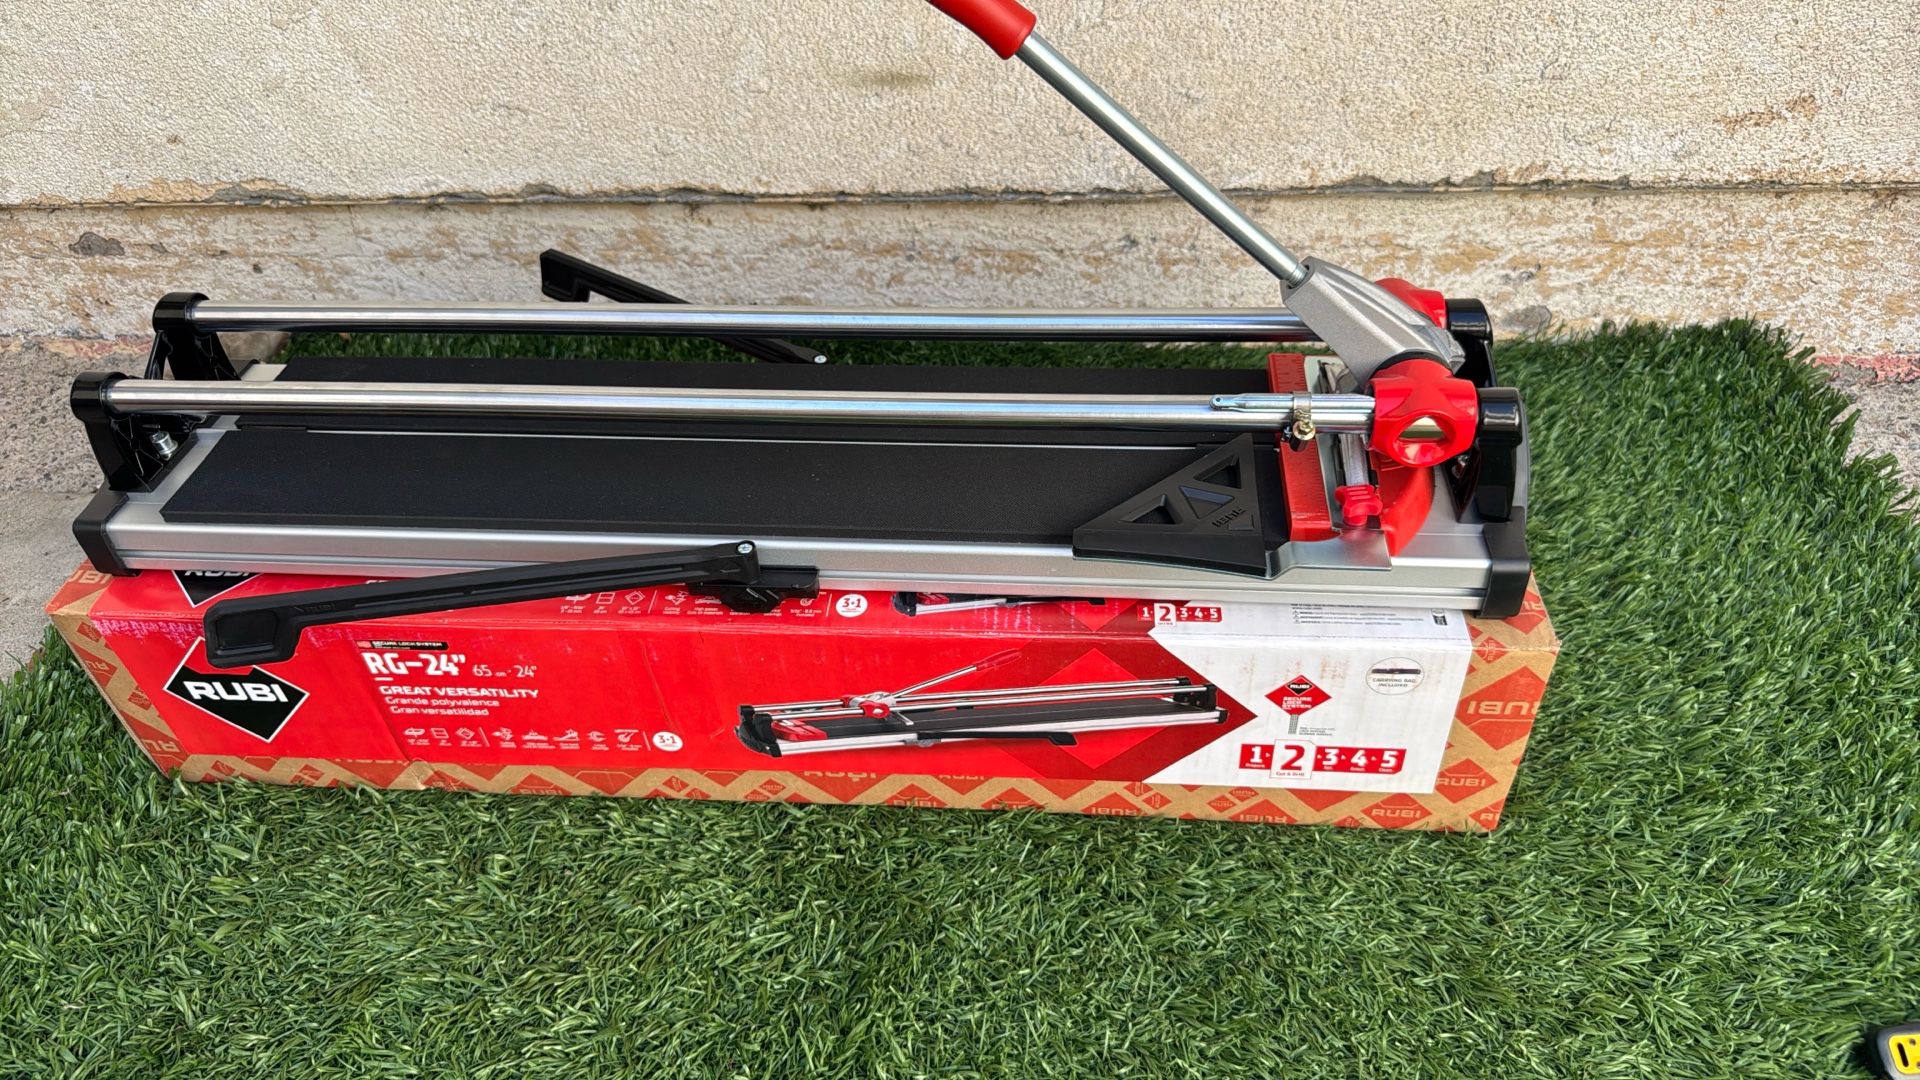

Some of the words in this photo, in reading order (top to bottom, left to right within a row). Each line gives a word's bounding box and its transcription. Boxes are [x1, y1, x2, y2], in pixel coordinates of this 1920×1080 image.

[1142, 606, 1149, 617] 1
[1159, 605, 1171, 621] 2
[1180, 607, 1188, 618] 3
[1194, 607, 1203, 618] 4
[1210, 608, 1218, 619] 5
[472, 664, 492, 677] 65
[182, 680, 289, 702] RUBI
[379, 685, 432, 695] GREAT
[434, 687, 539, 698] VERSATILITY
[385, 696, 428, 705] Grande
[431, 697, 500, 707] polyvalence
[390, 706, 420, 714] Gran
[423, 707, 490, 716] versatilidad
[1250, 746, 1263, 763] 1
[1280, 744, 1305, 771] 2
[1322, 748, 1339, 765] 3
[1350, 749, 1367, 766] 4
[1380, 750, 1399, 768] 5
[1437, 778, 1486, 786] RUBI
[1371, 809, 1421, 818] RUBI
